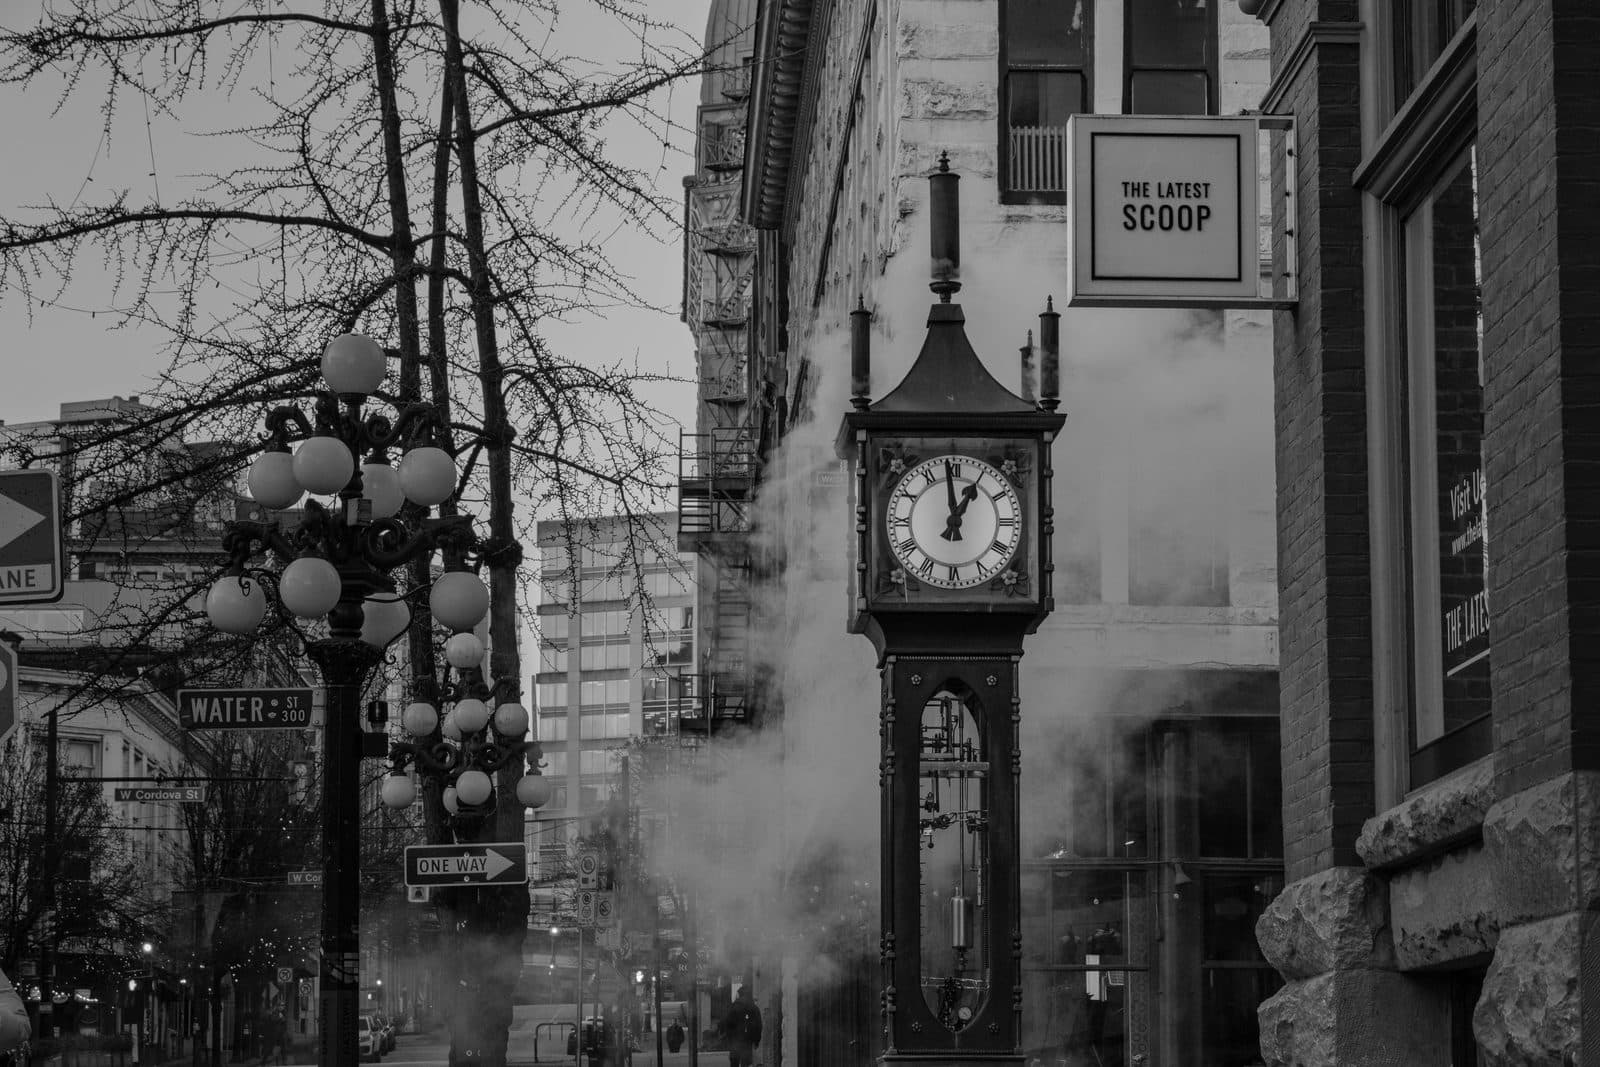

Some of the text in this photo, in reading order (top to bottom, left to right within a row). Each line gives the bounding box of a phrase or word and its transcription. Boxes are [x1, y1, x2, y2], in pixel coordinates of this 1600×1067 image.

[1121, 182, 1210, 199] THE LATEST
[1122, 204, 1211, 231] SCOOP
[901, 490, 917, 503] X
[1450, 479, 1471, 520] Visit
[999, 517, 1014, 527] III
[976, 560, 988, 574] V
[1446, 604, 1462, 653] THE
[190, 696, 264, 723] WATER
[286, 696, 299, 709] ST
[281, 709, 306, 722] 300
[120, 789, 199, 800] W Cordova St
[419, 857, 487, 873] ONE WAY
[292, 873, 302, 882] W
